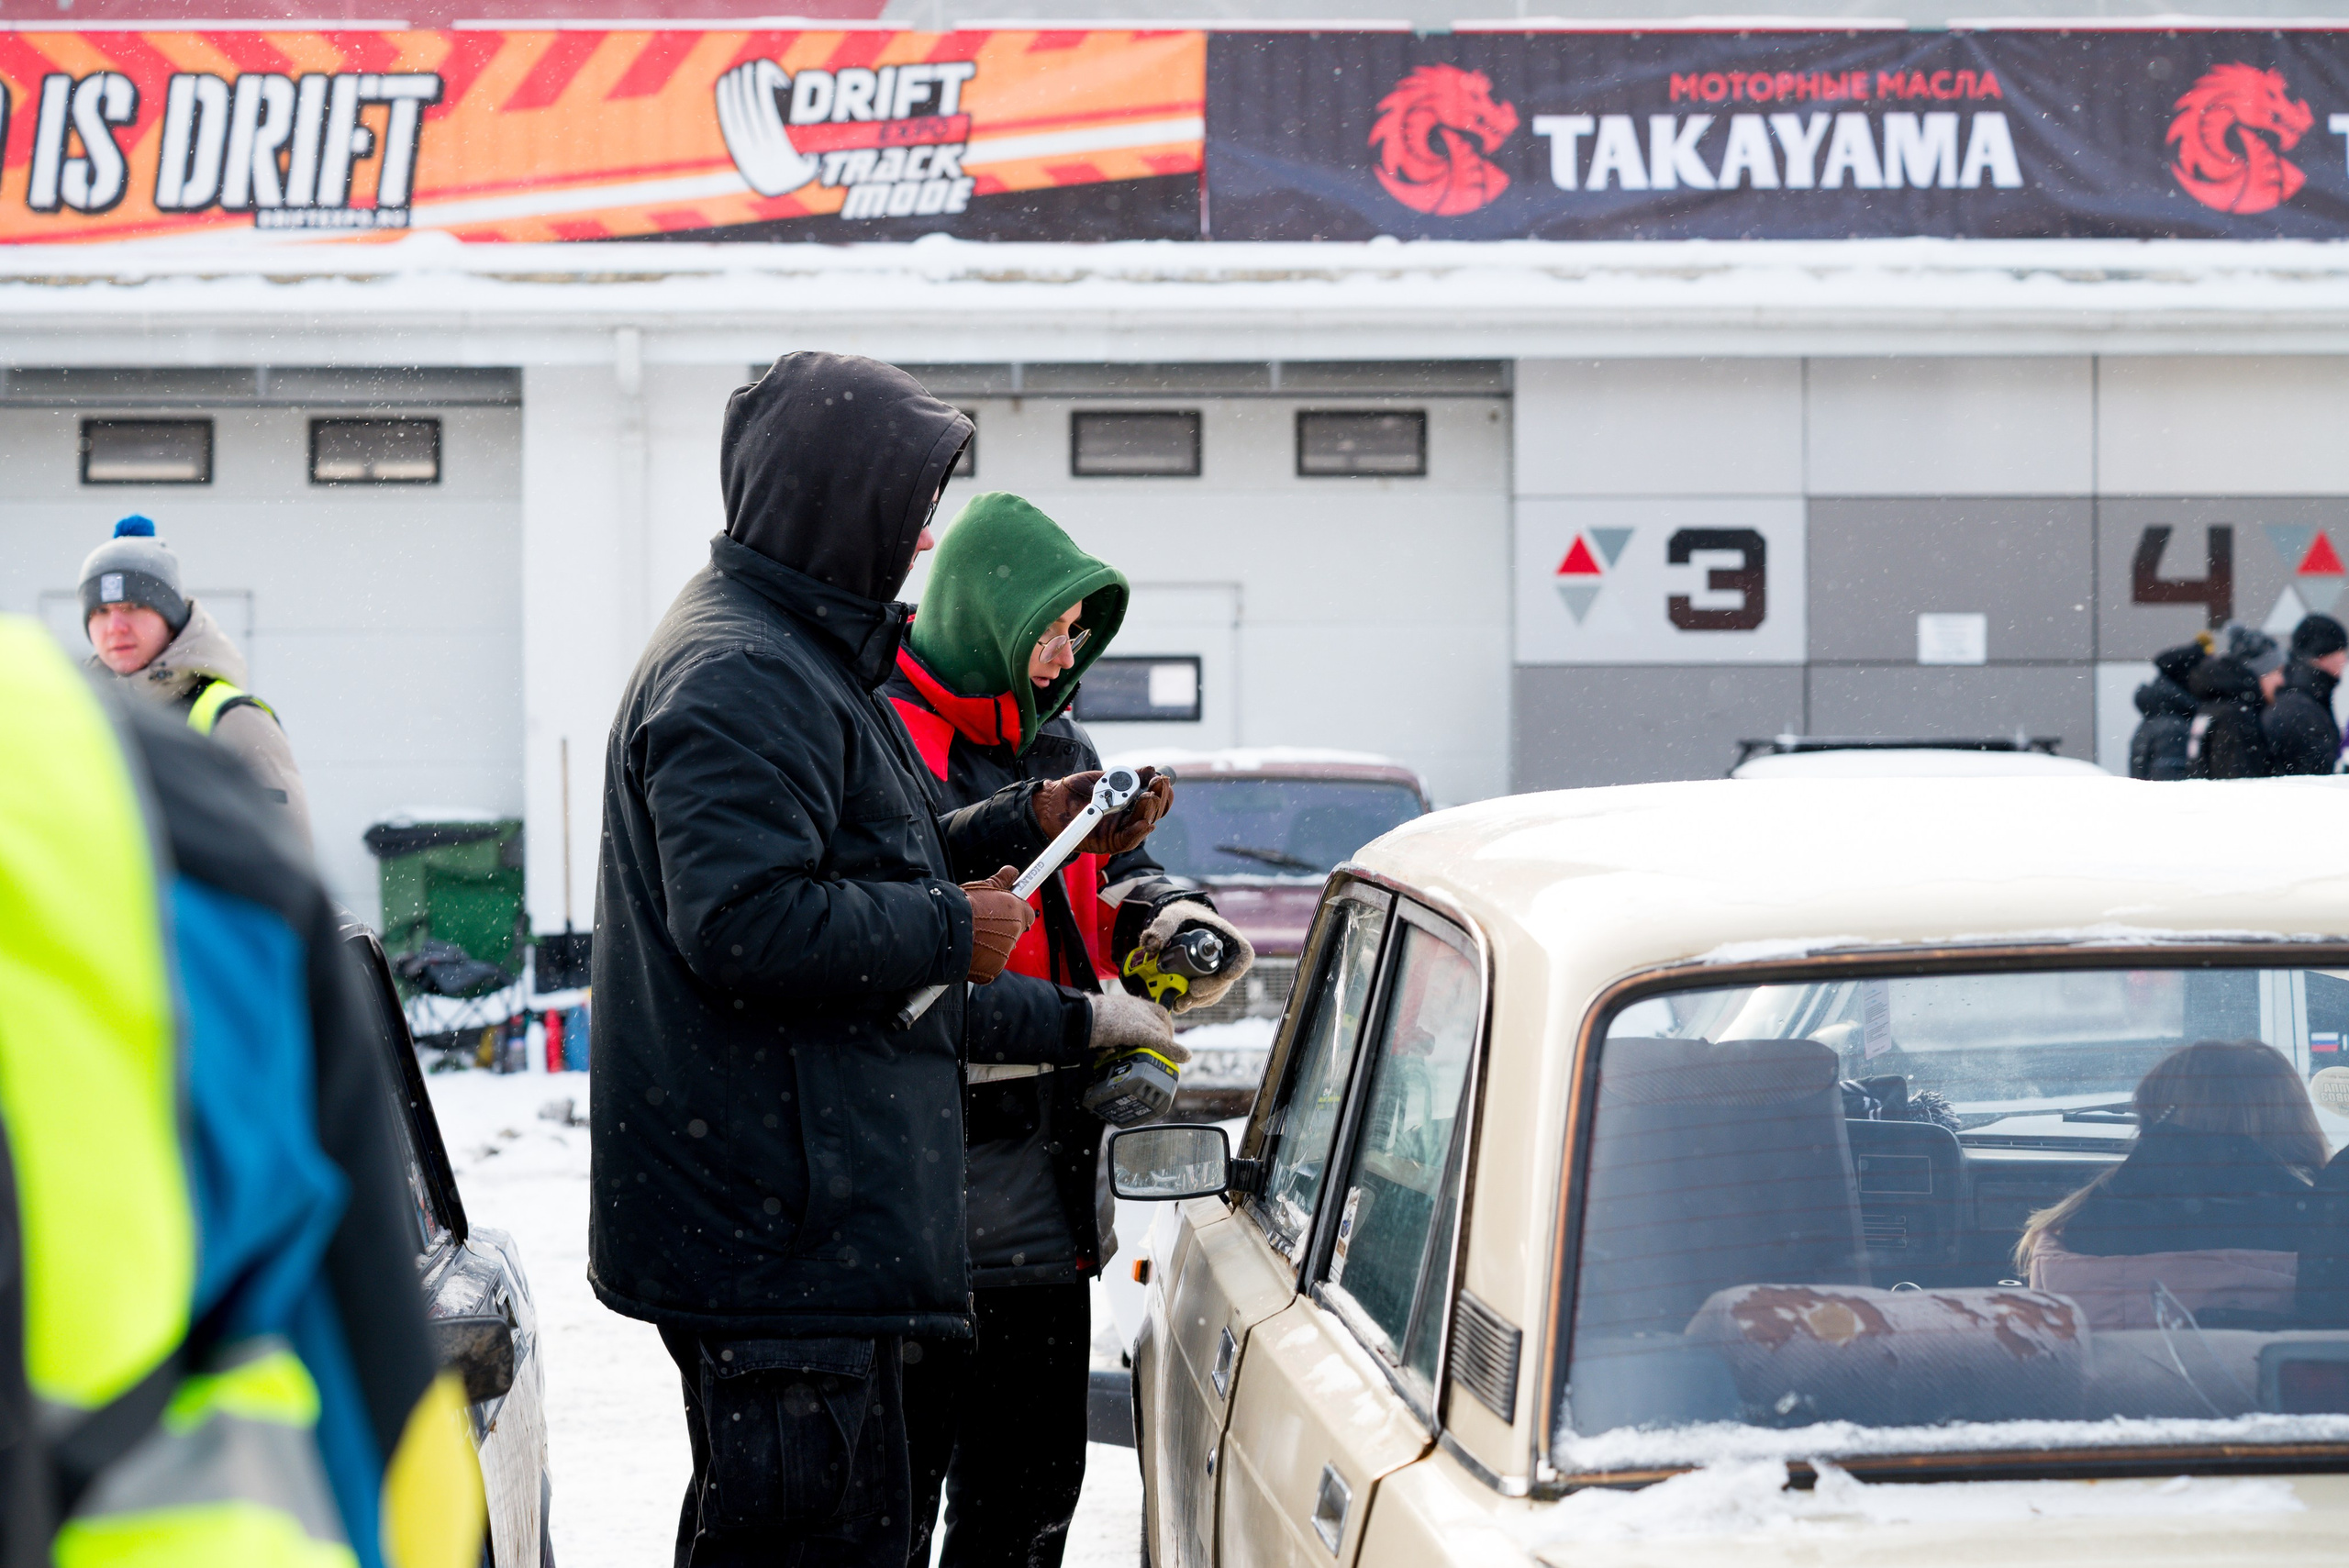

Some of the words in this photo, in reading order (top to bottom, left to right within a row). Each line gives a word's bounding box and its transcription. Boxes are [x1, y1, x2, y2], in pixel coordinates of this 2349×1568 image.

[790, 61, 975, 124] DRIFT
[1669, 72, 1869, 102] МОТОРНЫЕ
[1877, 70, 2003, 99] МАСЛА
[28, 72, 139, 212] IS
[154, 72, 443, 211] DRIFT
[821, 143, 966, 188] TRACK
[1532, 112, 2023, 191] TAKAYAMA
[841, 177, 975, 219] MODE
[1668, 528, 1766, 630] 3
[2132, 524, 2232, 629] 4
[1019, 861, 1045, 891] GIGANT
